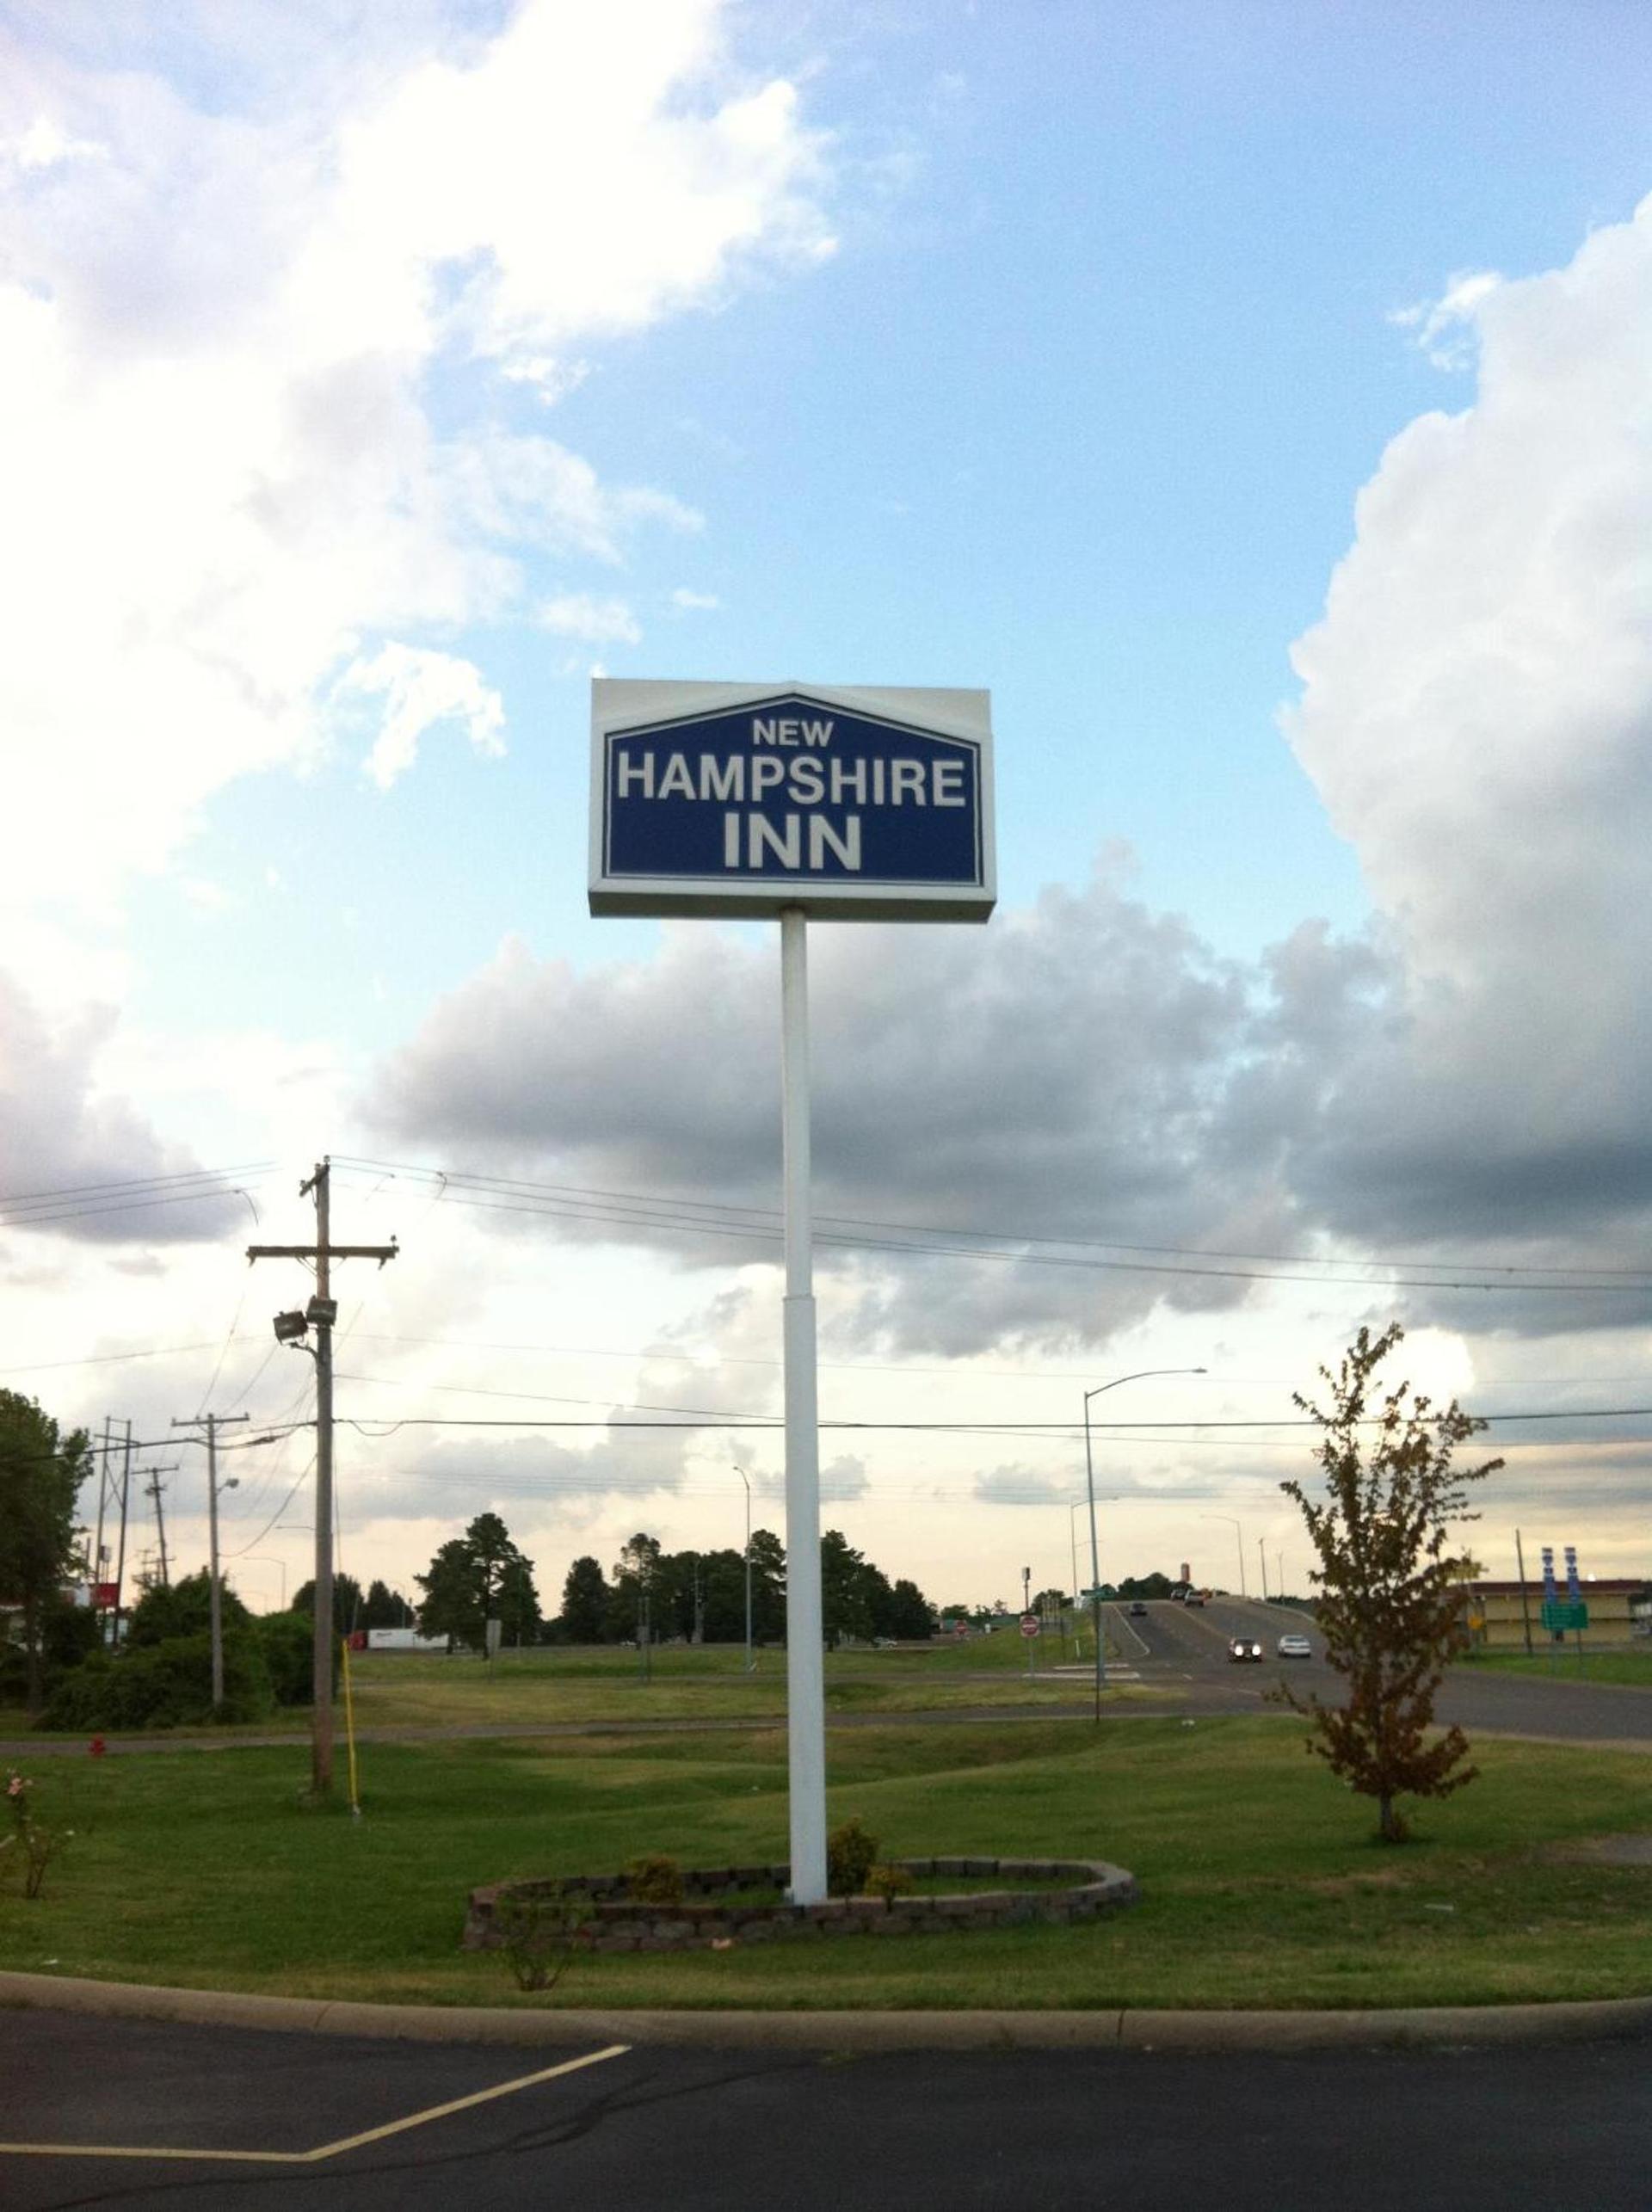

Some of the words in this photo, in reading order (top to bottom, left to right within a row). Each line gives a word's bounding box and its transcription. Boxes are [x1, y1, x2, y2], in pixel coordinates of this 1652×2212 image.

[753, 719, 834, 747] NEW
[618, 751, 965, 807] HAMPSHIRE
[724, 811, 861, 871] INN
